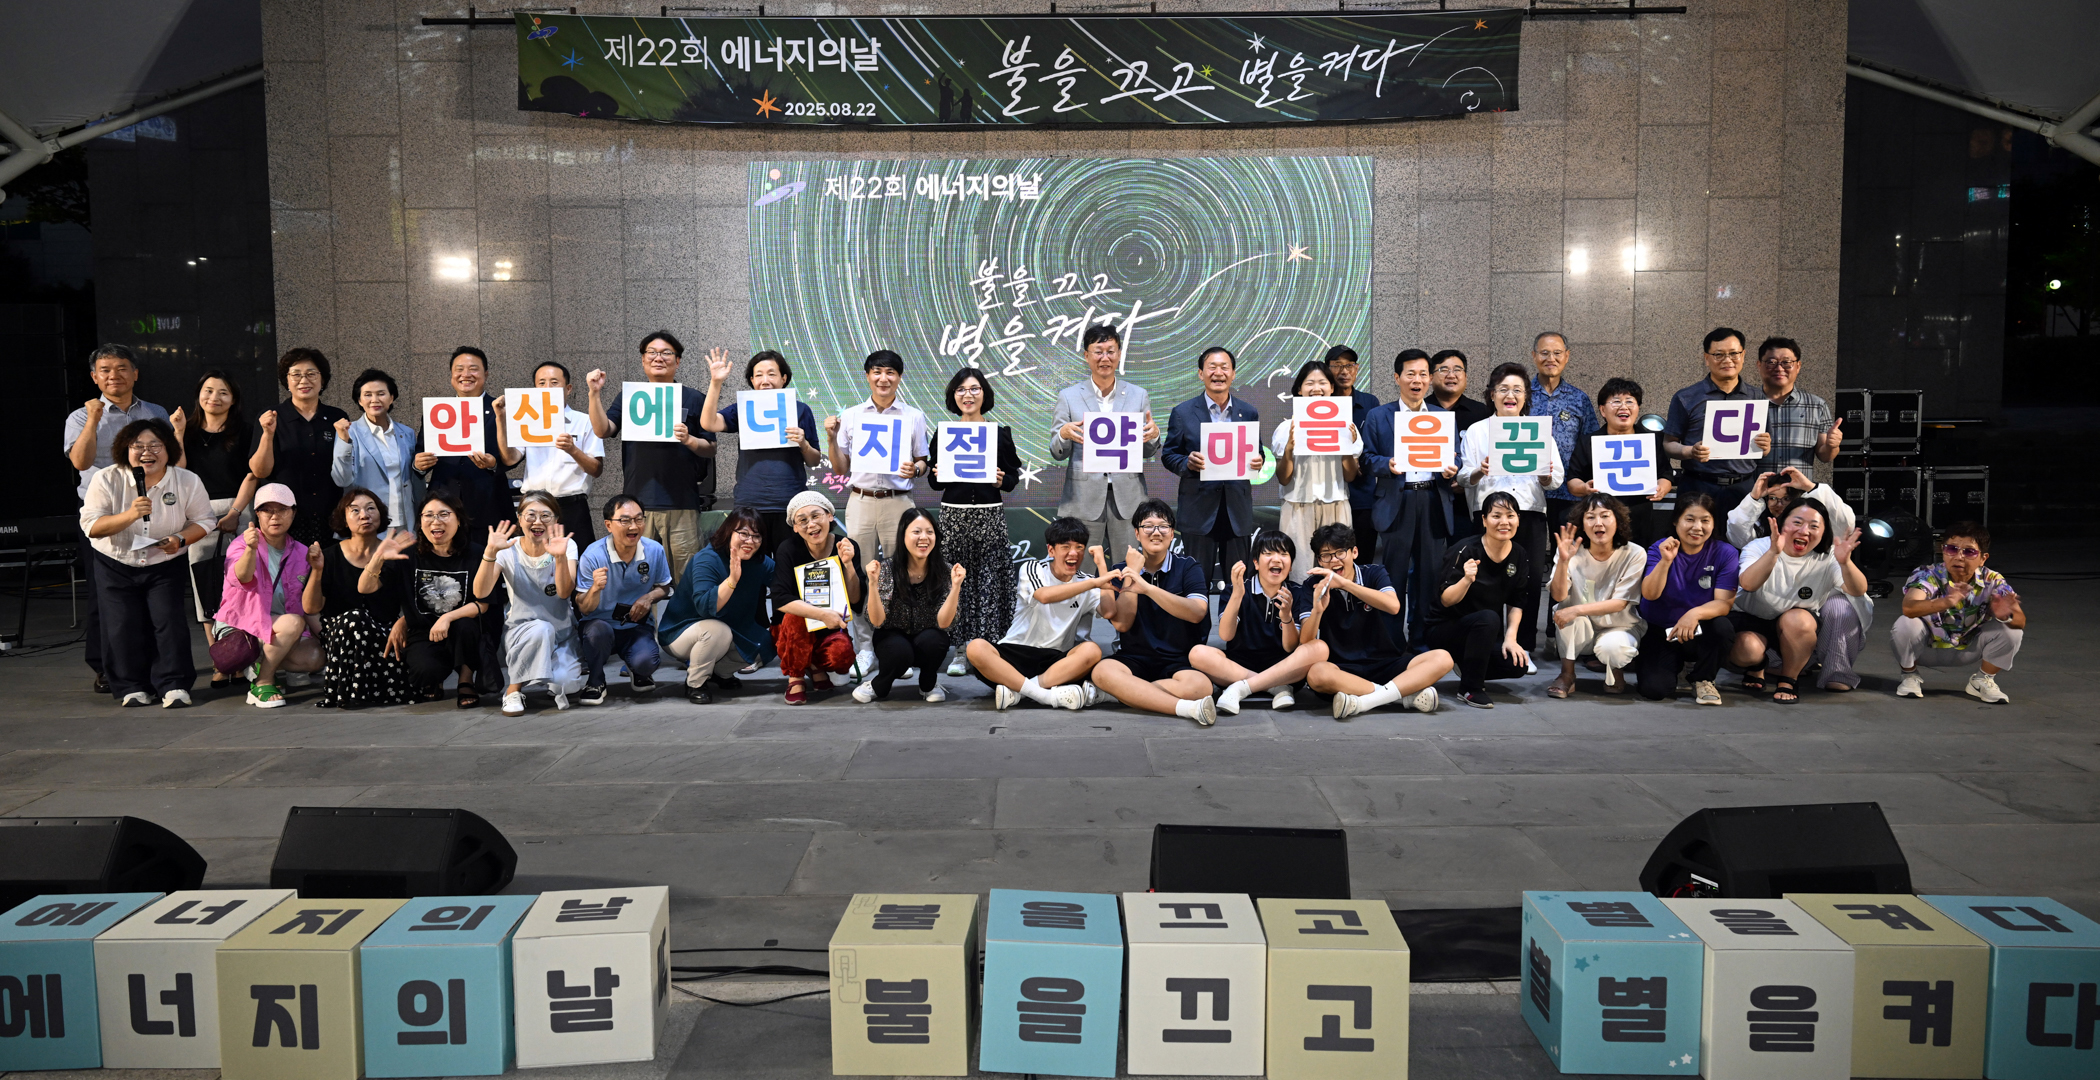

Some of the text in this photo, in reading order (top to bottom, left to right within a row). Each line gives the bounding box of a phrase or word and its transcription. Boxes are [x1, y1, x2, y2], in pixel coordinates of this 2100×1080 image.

[603, 34, 882, 73] 제22회 에너지의날
[988, 35, 1424, 117] 불을 끄고 별을 켜다
[784, 103, 877, 118] 2025.08.22
[825, 173, 1043, 202] 제22회 에너지의날
[969, 256, 1123, 310] 불을 끄고
[939, 313, 1038, 379] 별을
[429, 402, 478, 452] 안
[513, 391, 559, 443] 산
[629, 386, 674, 438] 에
[746, 393, 789, 445] 너
[1298, 399, 1347, 452] 을
[1713, 403, 1760, 456] 다
[858, 418, 901, 472] 지
[944, 426, 988, 480] 절
[1088, 416, 1136, 470] 약
[1207, 429, 1254, 477] 마
[1400, 415, 1449, 468] 을
[1495, 422, 1546, 473] 꿈
[1598, 439, 1651, 491] 꾼
[15, 901, 119, 927] 에
[154, 899, 240, 925] 너
[268, 908, 364, 936] 지
[407, 905, 496, 932] 의
[554, 895, 634, 923] 날
[871, 903, 941, 930] 불
[1019, 901, 1088, 930] 을
[1157, 902, 1229, 929] 끄
[1294, 908, 1370, 936] 고
[1565, 901, 1655, 928] 별
[1708, 908, 1800, 936] 을
[1833, 903, 1936, 931] 켜
[1968, 905, 2075, 933] 다
[127, 972, 197, 1037] 너
[250, 984, 320, 1050] 지
[396, 978, 468, 1045] 의
[546, 966, 621, 1033] 날
[863, 978, 933, 1044] 불
[1016, 976, 1087, 1044] 을
[1162, 977, 1232, 1043] 끄
[1303, 984, 1375, 1052] 고
[1598, 976, 1668, 1043] 별
[1746, 984, 1820, 1053] 을
[1882, 979, 1955, 1048] 켜
